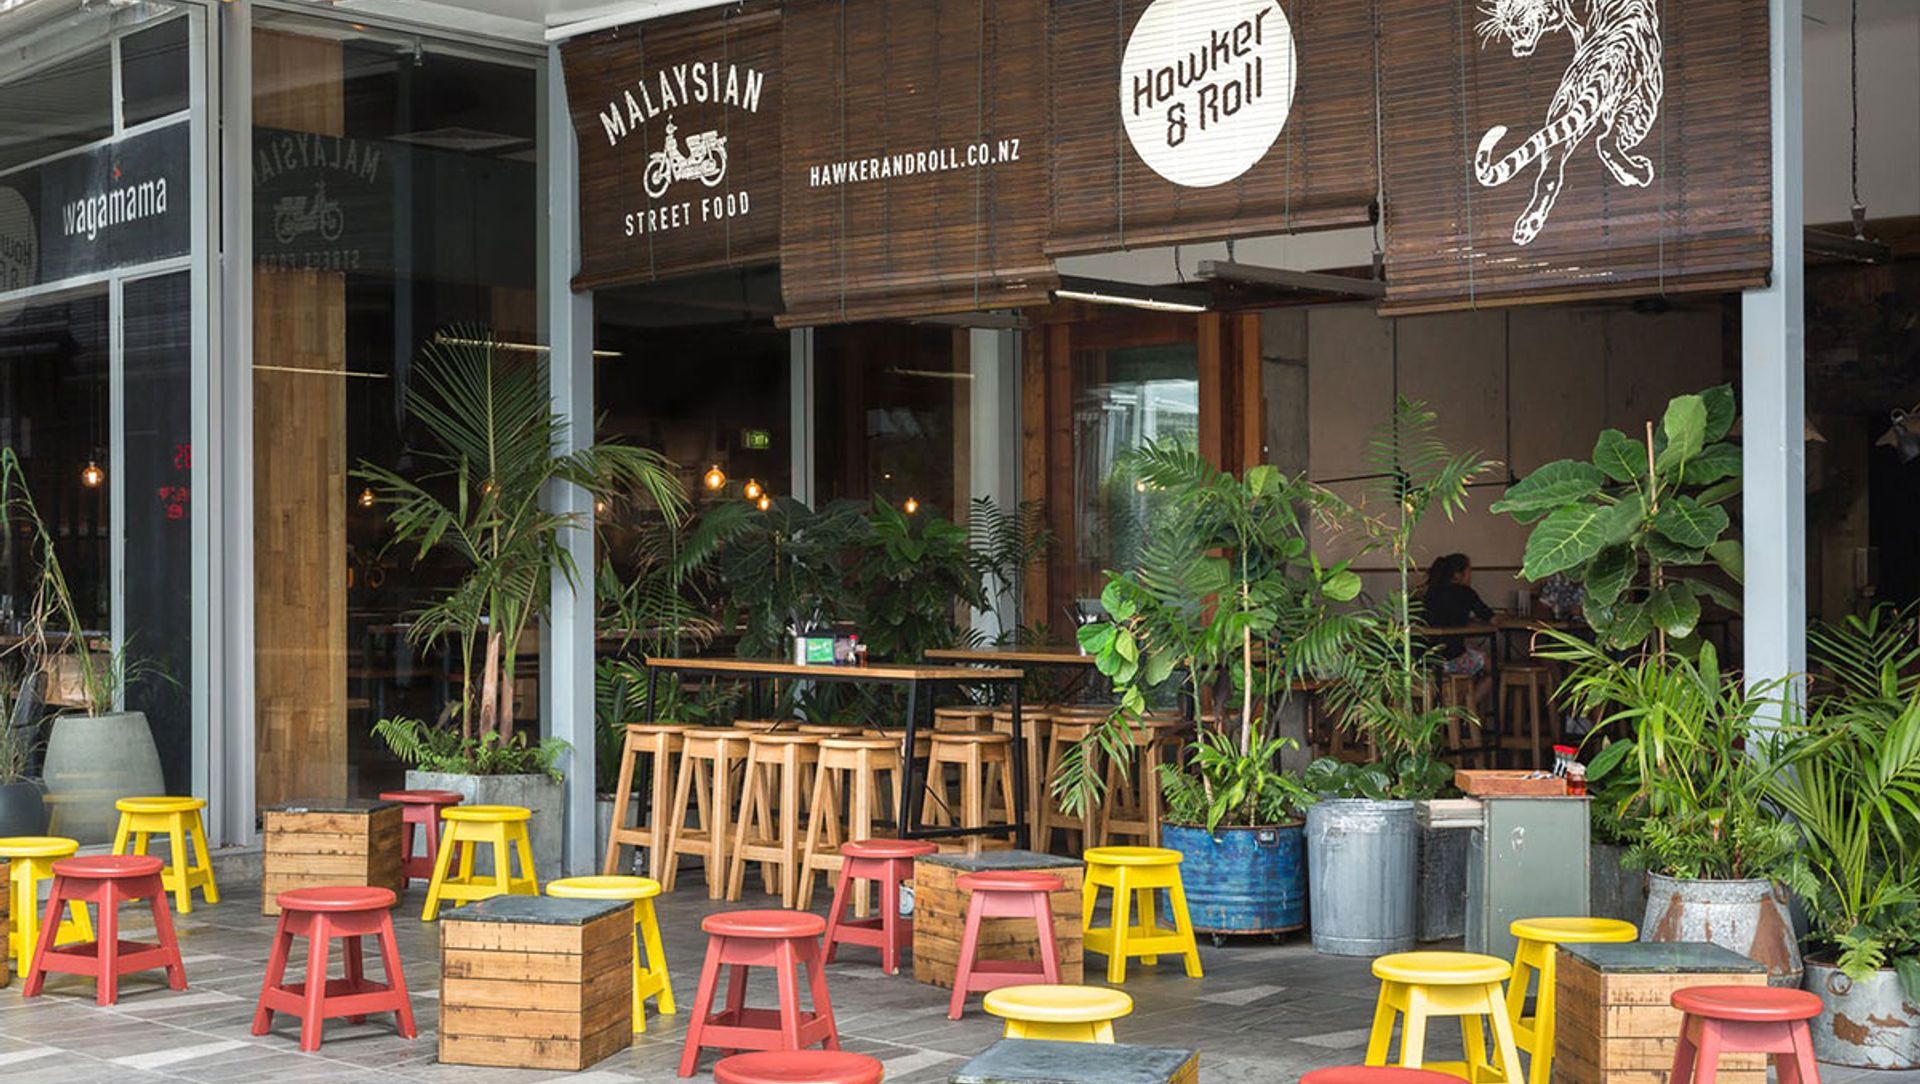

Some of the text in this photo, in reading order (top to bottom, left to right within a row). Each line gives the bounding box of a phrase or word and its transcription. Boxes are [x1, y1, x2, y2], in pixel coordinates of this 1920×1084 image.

[1133, 6, 1273, 116] Hawker
[599, 62, 764, 146] MALAYSIAN
[1166, 56, 1262, 148] & Roll
[810, 138, 1020, 187] HAWKERANDROLL.CO.NZ
[63, 177, 167, 241] wagamama
[625, 191, 750, 236] STREET FOOD
